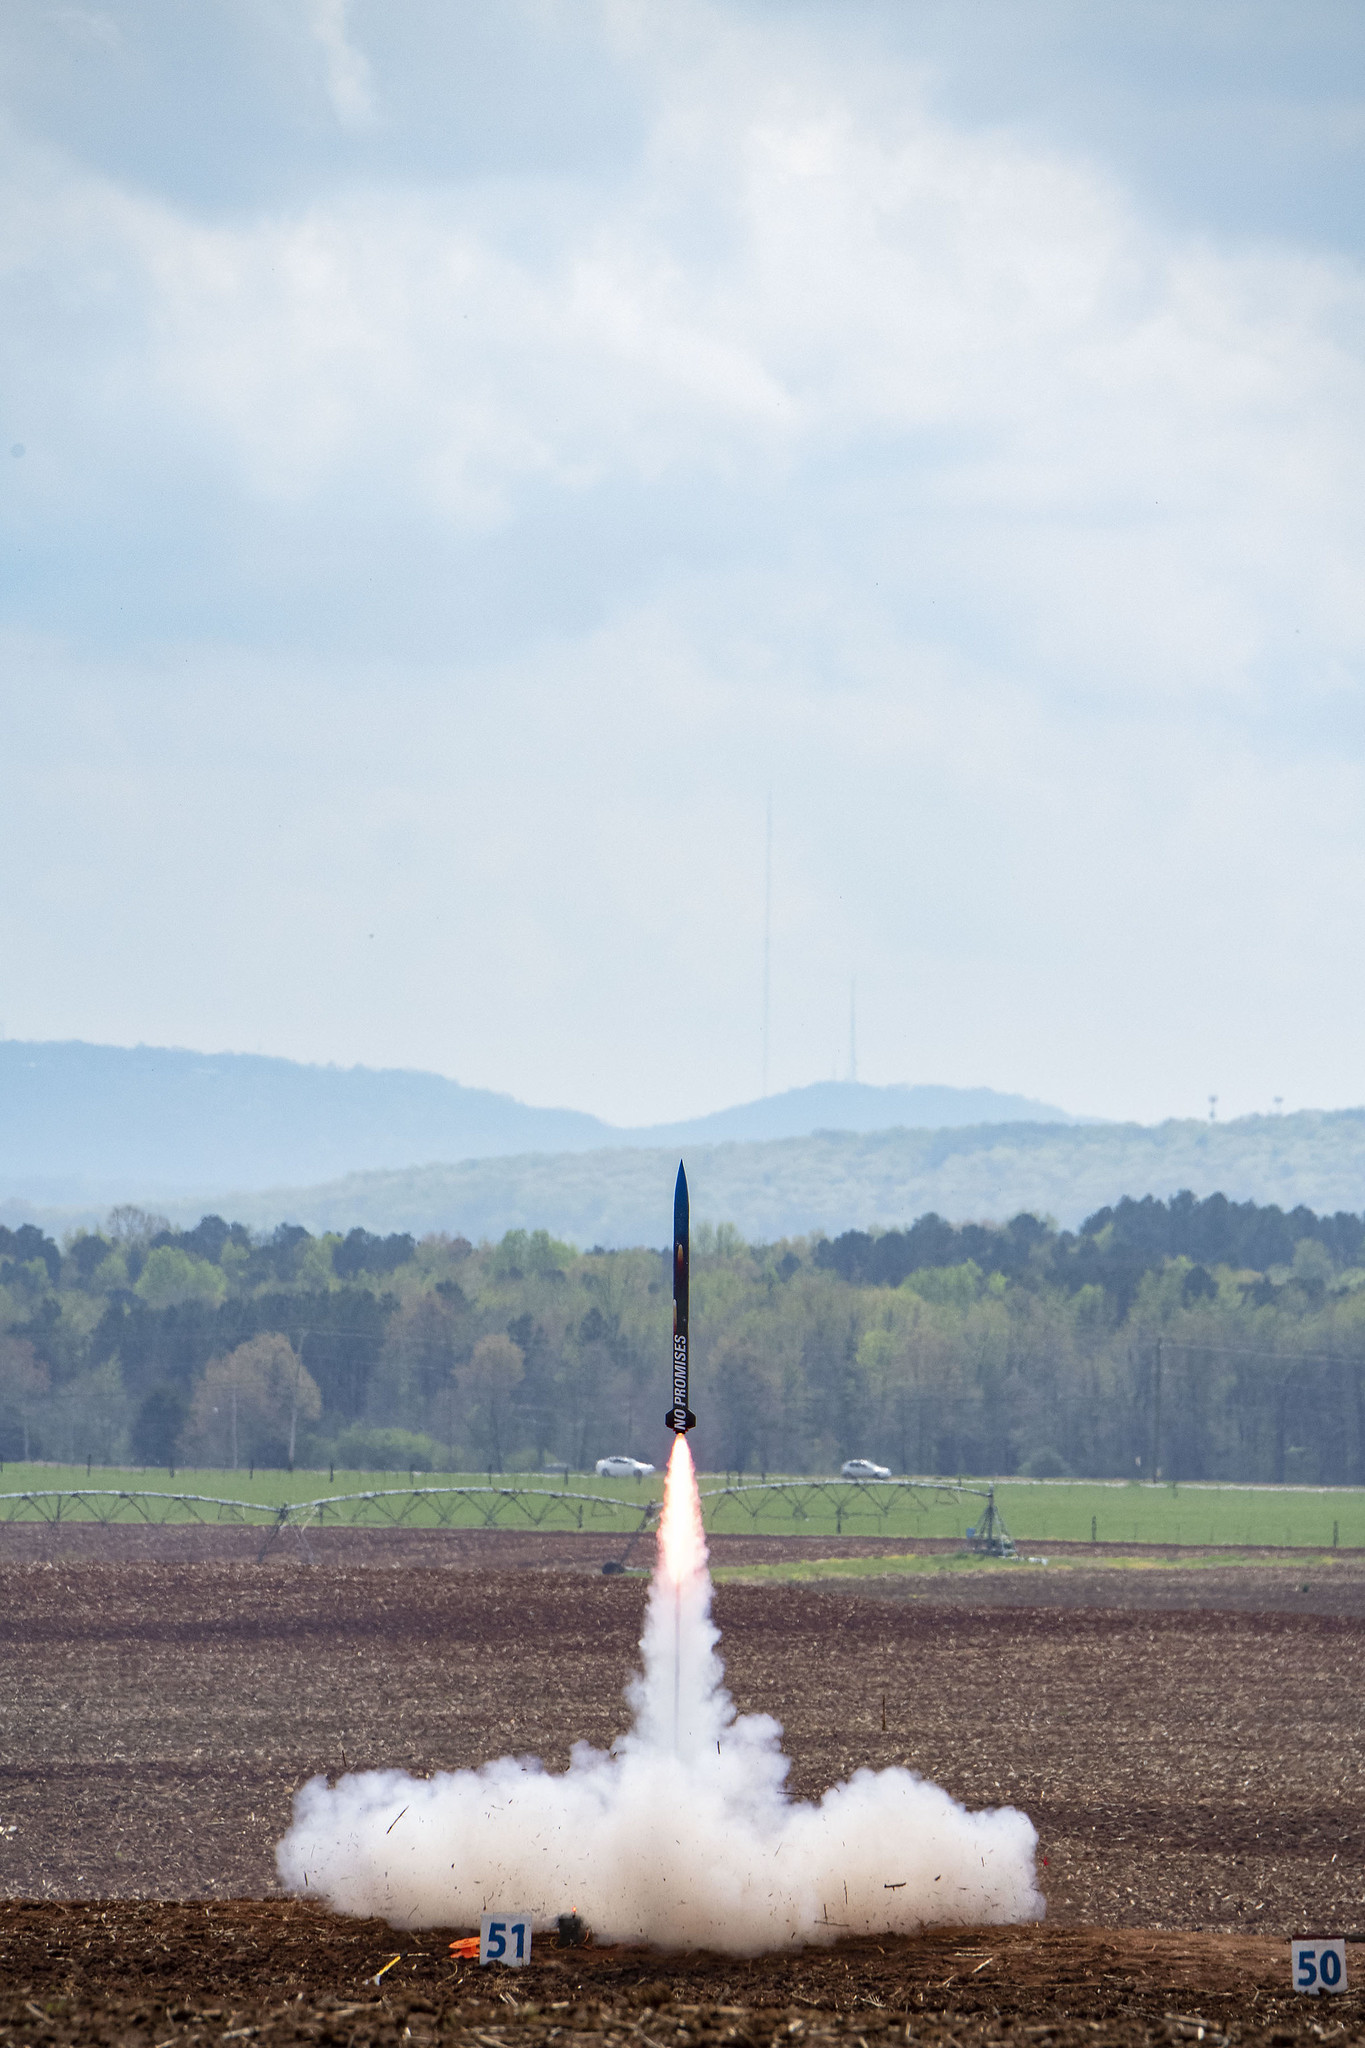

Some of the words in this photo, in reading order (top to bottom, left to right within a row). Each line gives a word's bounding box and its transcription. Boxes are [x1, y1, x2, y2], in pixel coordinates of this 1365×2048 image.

[674, 1334, 687, 1406] PROMISES
[674, 1408, 687, 1430] NO
[486, 1922, 525, 1958] 51
[1297, 1950, 1341, 1986] 50
